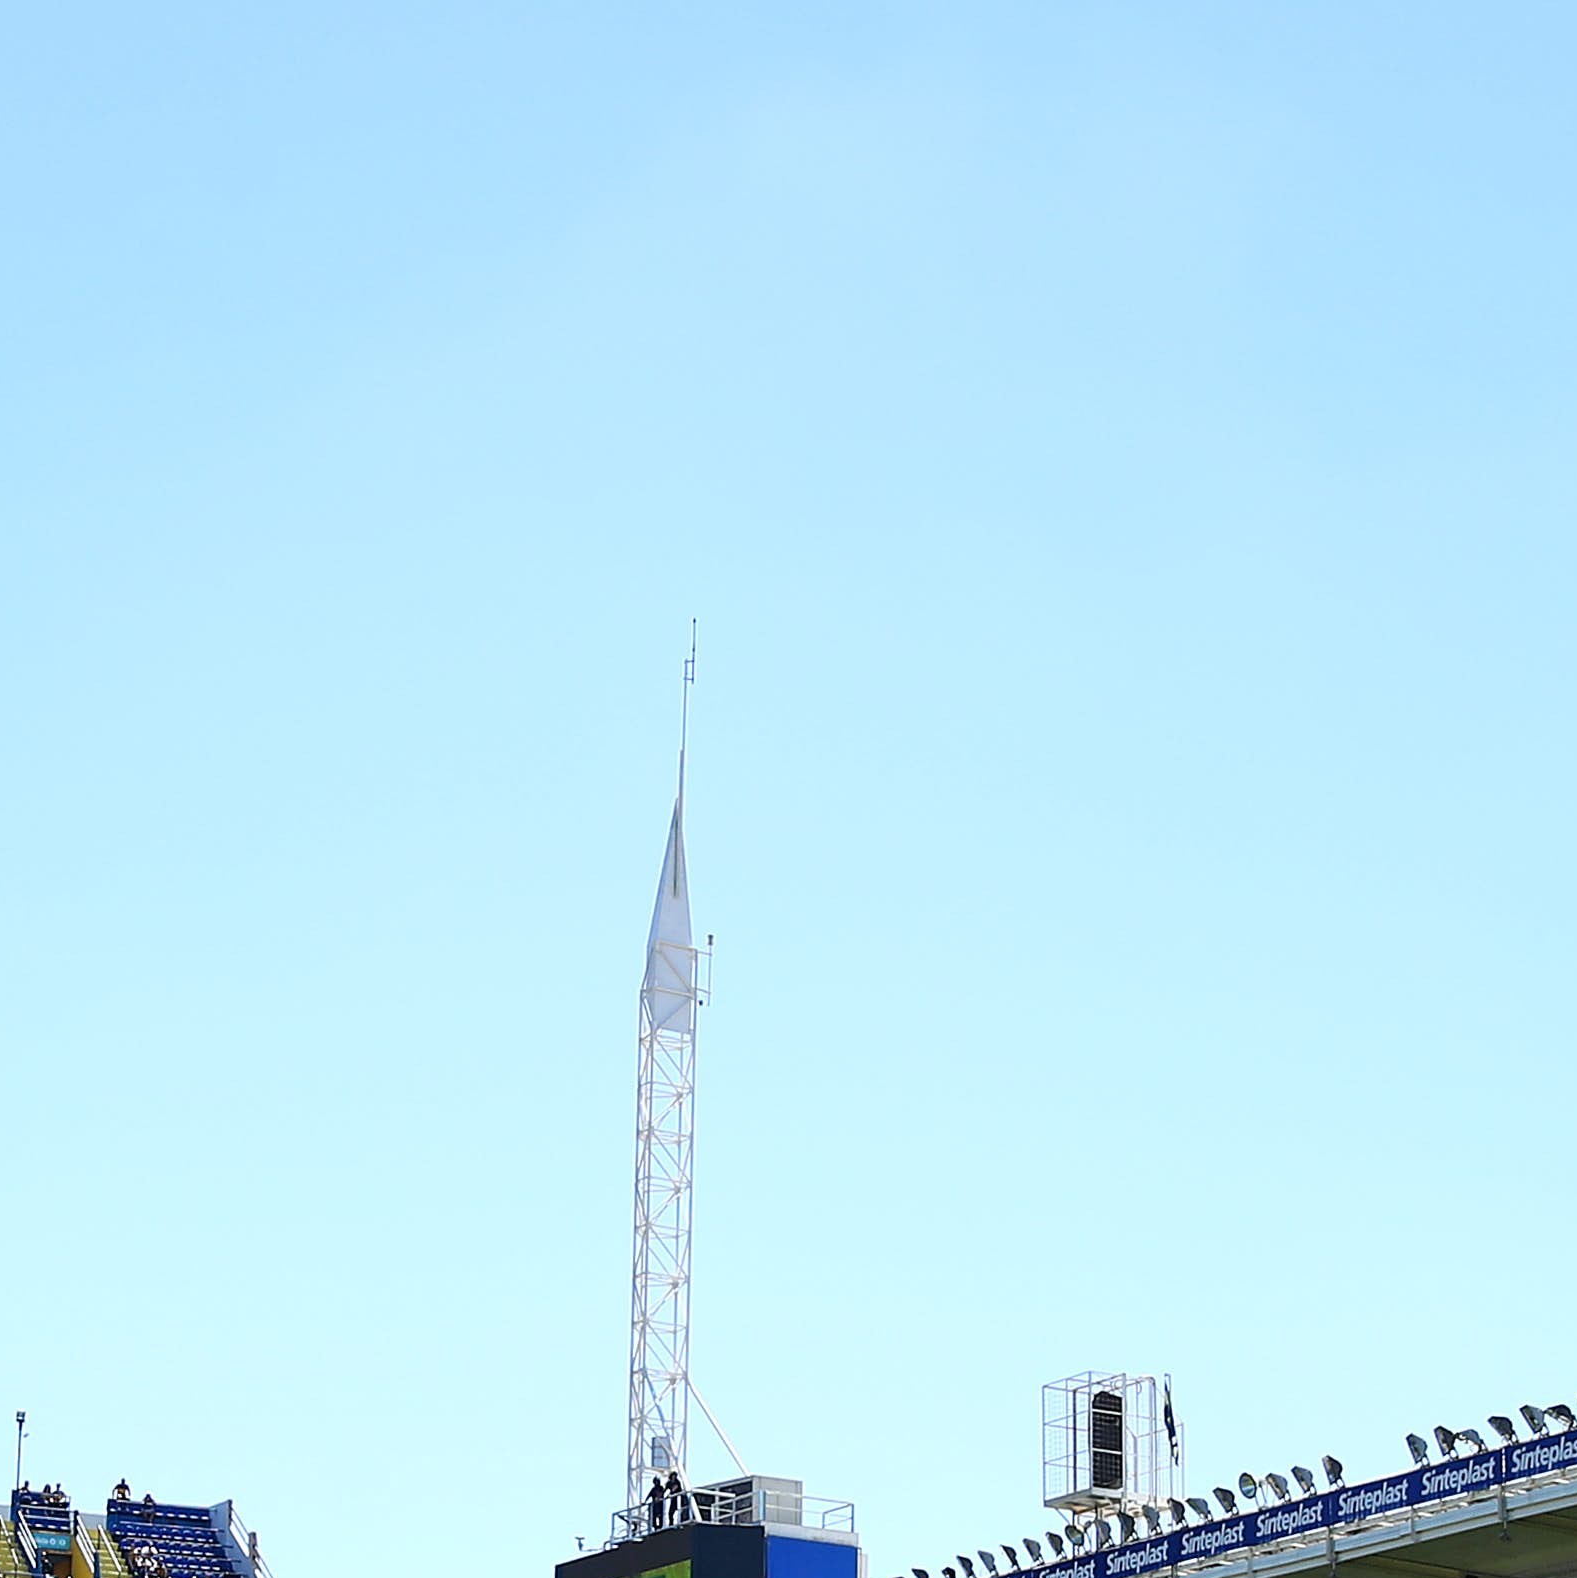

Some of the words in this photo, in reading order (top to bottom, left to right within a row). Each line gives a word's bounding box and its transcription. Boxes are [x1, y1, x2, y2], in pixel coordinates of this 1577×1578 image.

[1422, 1456, 1496, 1495] Sinteplast
[1338, 1478, 1408, 1516] Sinteplast
[1256, 1500, 1323, 1538] Sinteplast
[1106, 1540, 1169, 1576] Sinteplast
[1180, 1523, 1244, 1557] Sinteplast
